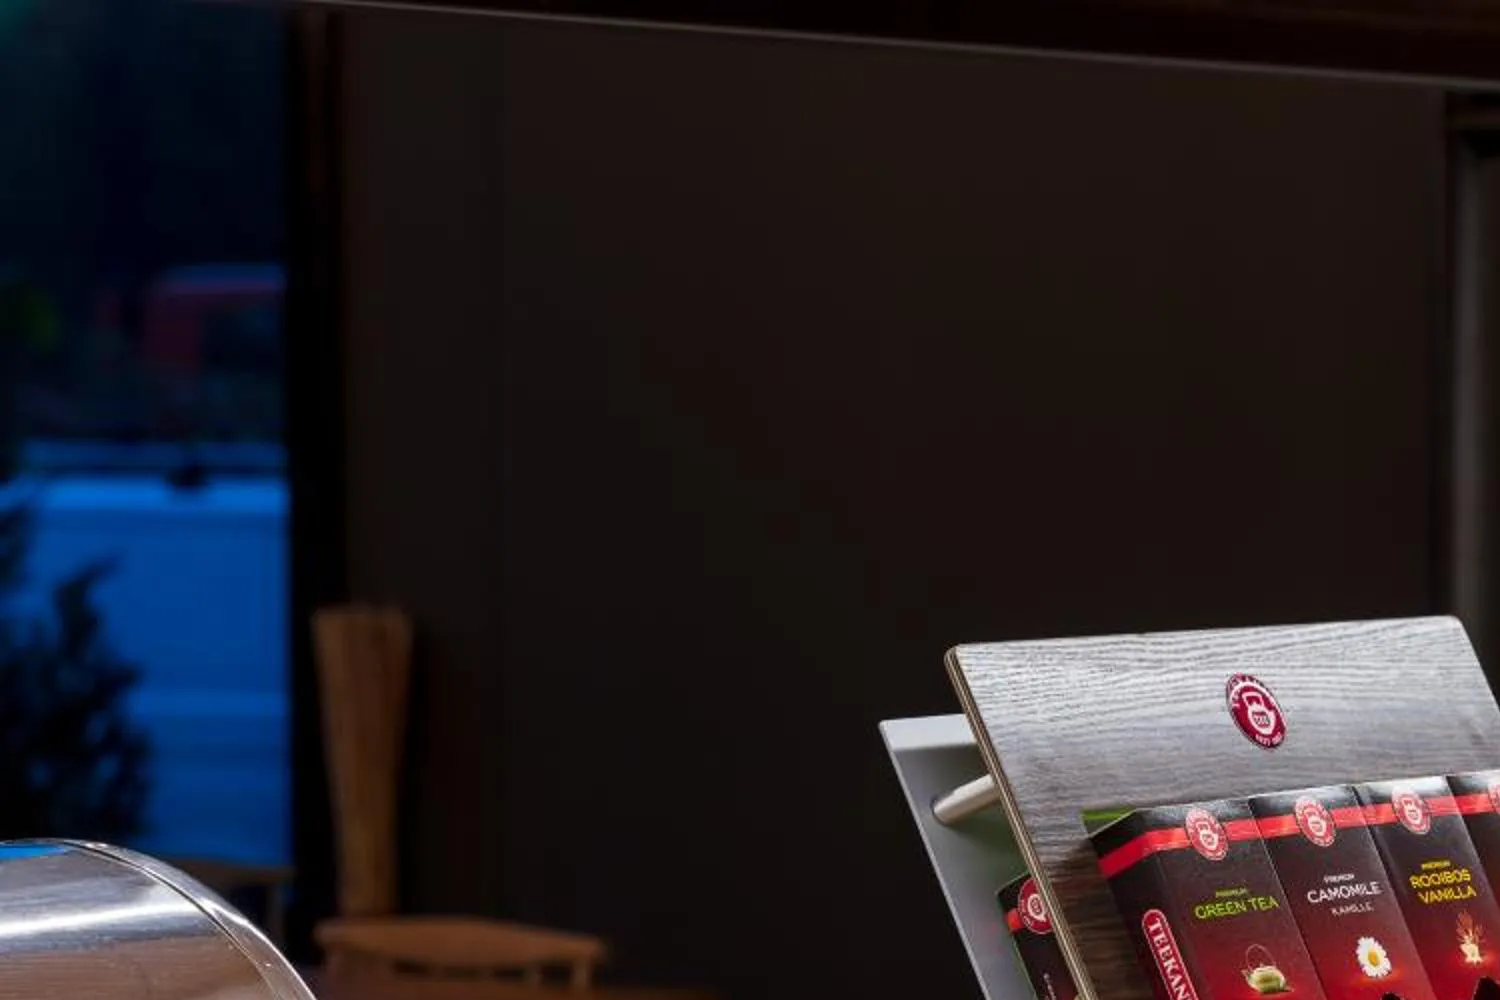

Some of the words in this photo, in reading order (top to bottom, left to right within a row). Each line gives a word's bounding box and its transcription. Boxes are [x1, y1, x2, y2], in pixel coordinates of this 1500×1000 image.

[1409, 868, 1472, 889] ROOIBOS
[1307, 881, 1383, 904] CAMOMILE
[1417, 885, 1477, 905] VANILLA
[1194, 900, 1247, 919] GREEN
[1247, 896, 1280, 912] TEA
